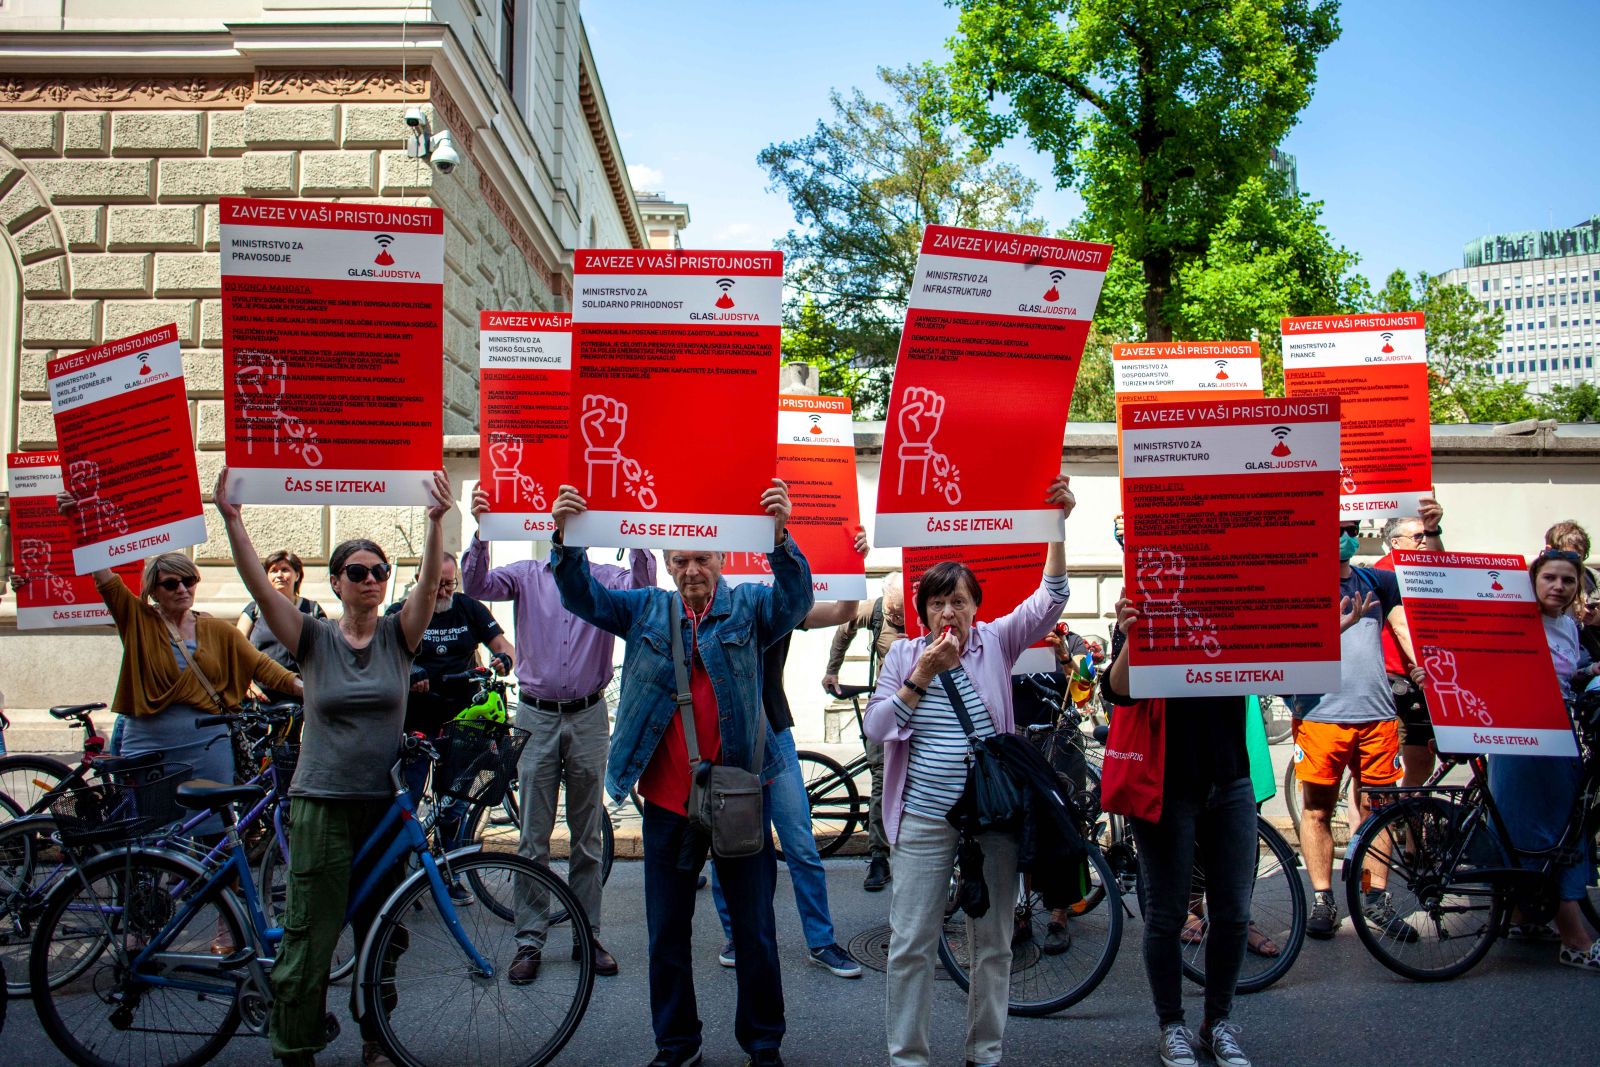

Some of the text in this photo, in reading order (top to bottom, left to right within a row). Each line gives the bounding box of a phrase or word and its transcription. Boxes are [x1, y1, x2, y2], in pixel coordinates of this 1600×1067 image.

[231, 205, 431, 226] ZAVEZE V VAŠI PRISTOJNOSTI
[232, 239, 289, 249] MINISTRSTVO
[933, 233, 1102, 264] ZAVEZE V VAŠI PRISTOJNOSTI
[232, 252, 291, 262] PRAVOSODJE
[585, 254, 771, 269] ZAVEZE V VAŠI PRISTOJNOSTI
[925, 269, 988, 283] MINISTRSTVO ZA
[922, 283, 992, 298] INFRASTRUKTURO
[582, 300, 683, 309] SOLIDARNO PRIHODNOST
[489, 316, 528, 326] ZAVEZE
[530, 317, 536, 326] V
[538, 316, 561, 326] VAŠI
[1288, 321, 1322, 330] ZAVEZE
[1332, 318, 1352, 328] VAŠI
[1354, 317, 1416, 327] PRISTOJNOSTI
[53, 330, 170, 373] ZAVEZE V VAŠI PRISTOJNOSTI
[1120, 347, 1154, 355] ZAVEZE
[1164, 345, 1184, 355] VAŠI
[1187, 346, 1251, 354] PRISTOJNOSTI
[55, 374, 89, 388] MINISTRSTVO
[78, 377, 106, 390] PODNEBJE
[58, 394, 83, 406] ENERGIJO
[782, 398, 844, 410] PRISTOJNOSTI
[1133, 403, 1328, 422] ZAVEZE V VAŠI PRISTOJNOSTI
[1133, 441, 1188, 450] MINISTRSTVO
[14, 455, 45, 464] ZAVEZE
[1133, 453, 1209, 462] INFRASTRUKTURO
[284, 477, 385, 493] ČAS SE IZTEKA!
[1339, 500, 1398, 510] AS SE IZTEKA!
[524, 518, 544, 530] ČAS
[620, 520, 716, 537] ČAS SE IZTEKA!
[926, 516, 1013, 531] ČAS SE IZTEKA!
[108, 532, 170, 557] ČAS SE IZTEKA!
[1399, 554, 1432, 562] ZAVEZE
[1439, 554, 1459, 563] VAŠI
[1460, 556, 1520, 566] PRISTOJNOSTI
[53, 610, 69, 619] ČAS
[448, 625, 468, 634] SPEECH
[1185, 668, 1283, 683] ČAS SE IZTEKA!
[1472, 733, 1538, 745] ČAS SE IZTEKA!
